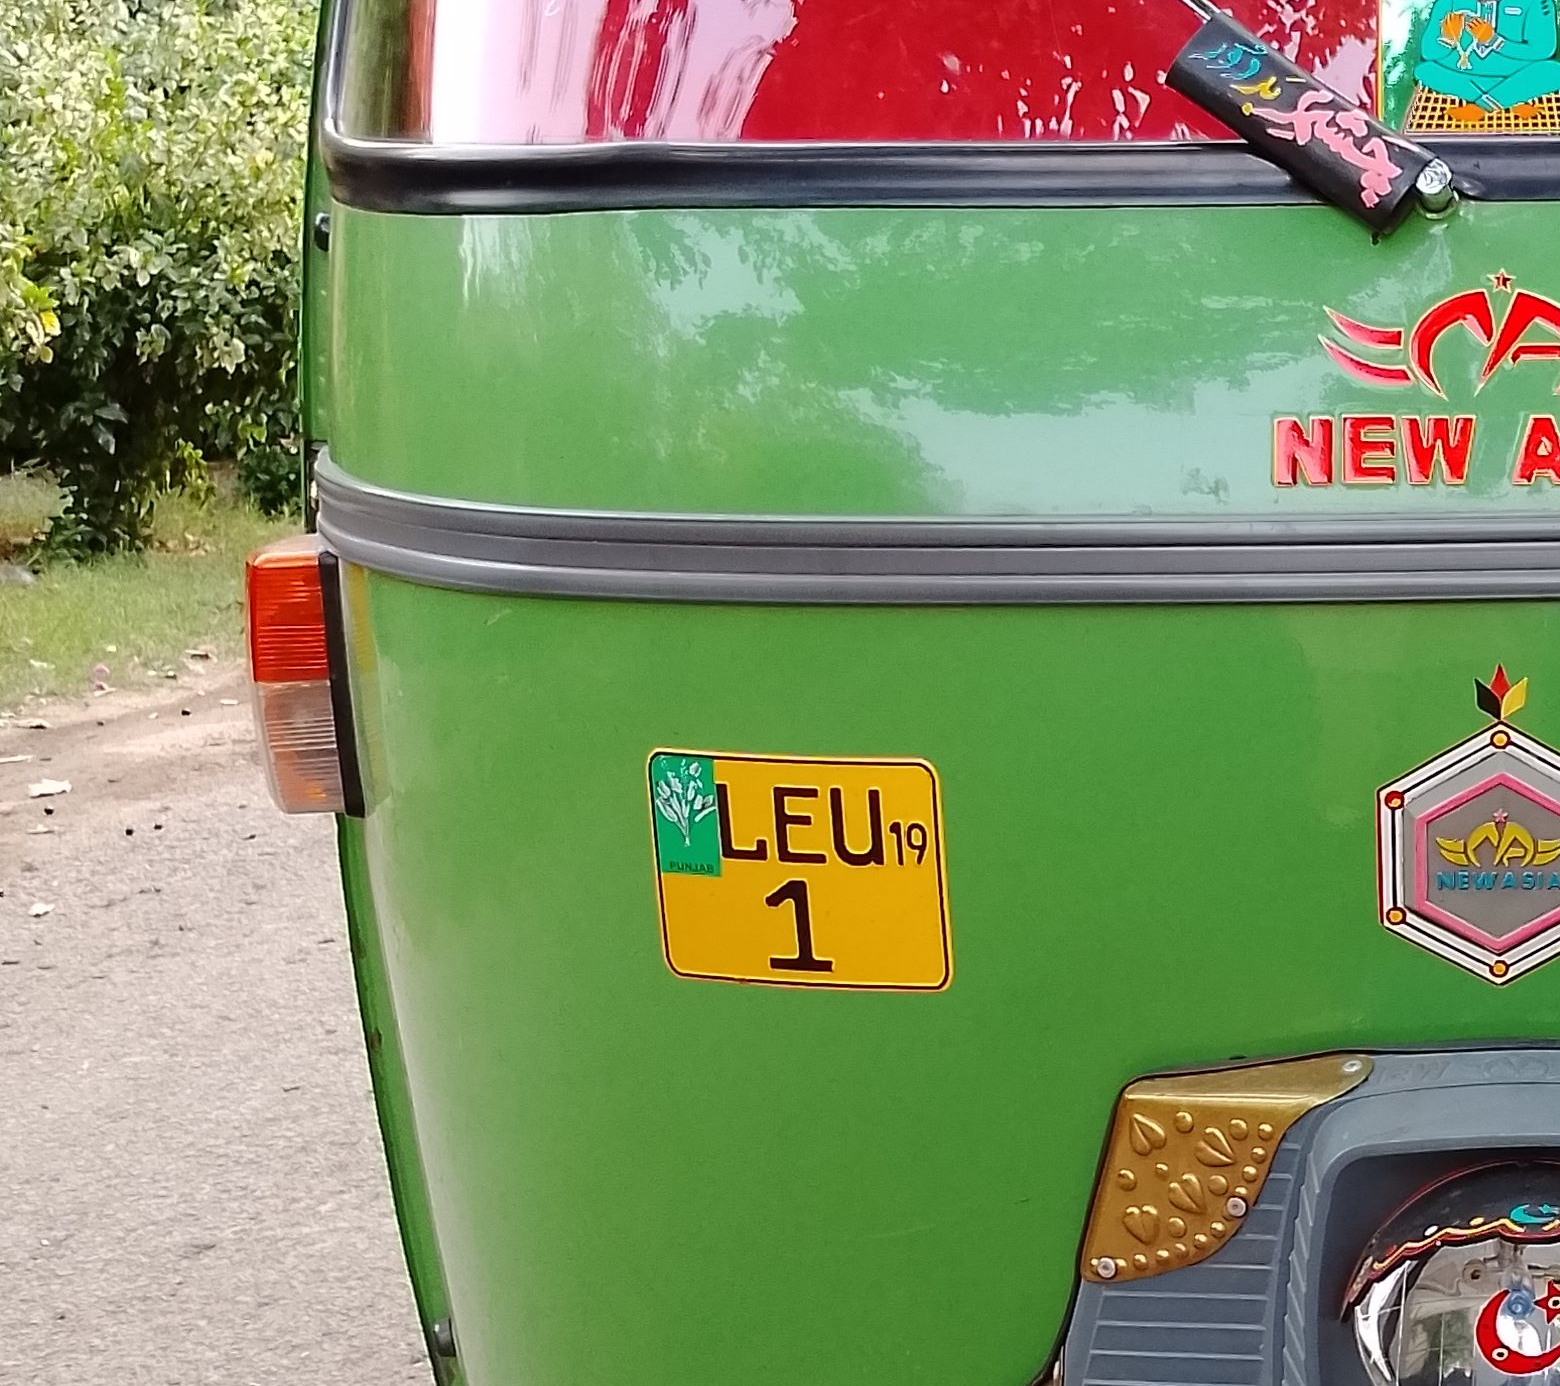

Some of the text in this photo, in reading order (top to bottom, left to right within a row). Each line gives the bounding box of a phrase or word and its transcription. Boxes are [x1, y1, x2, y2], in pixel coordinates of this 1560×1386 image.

[1273, 413, 1478, 486] NEW
[716, 783, 884, 866] LEU
[669, 860, 714, 874] PUNJAB
[765, 879, 834, 973] 1
